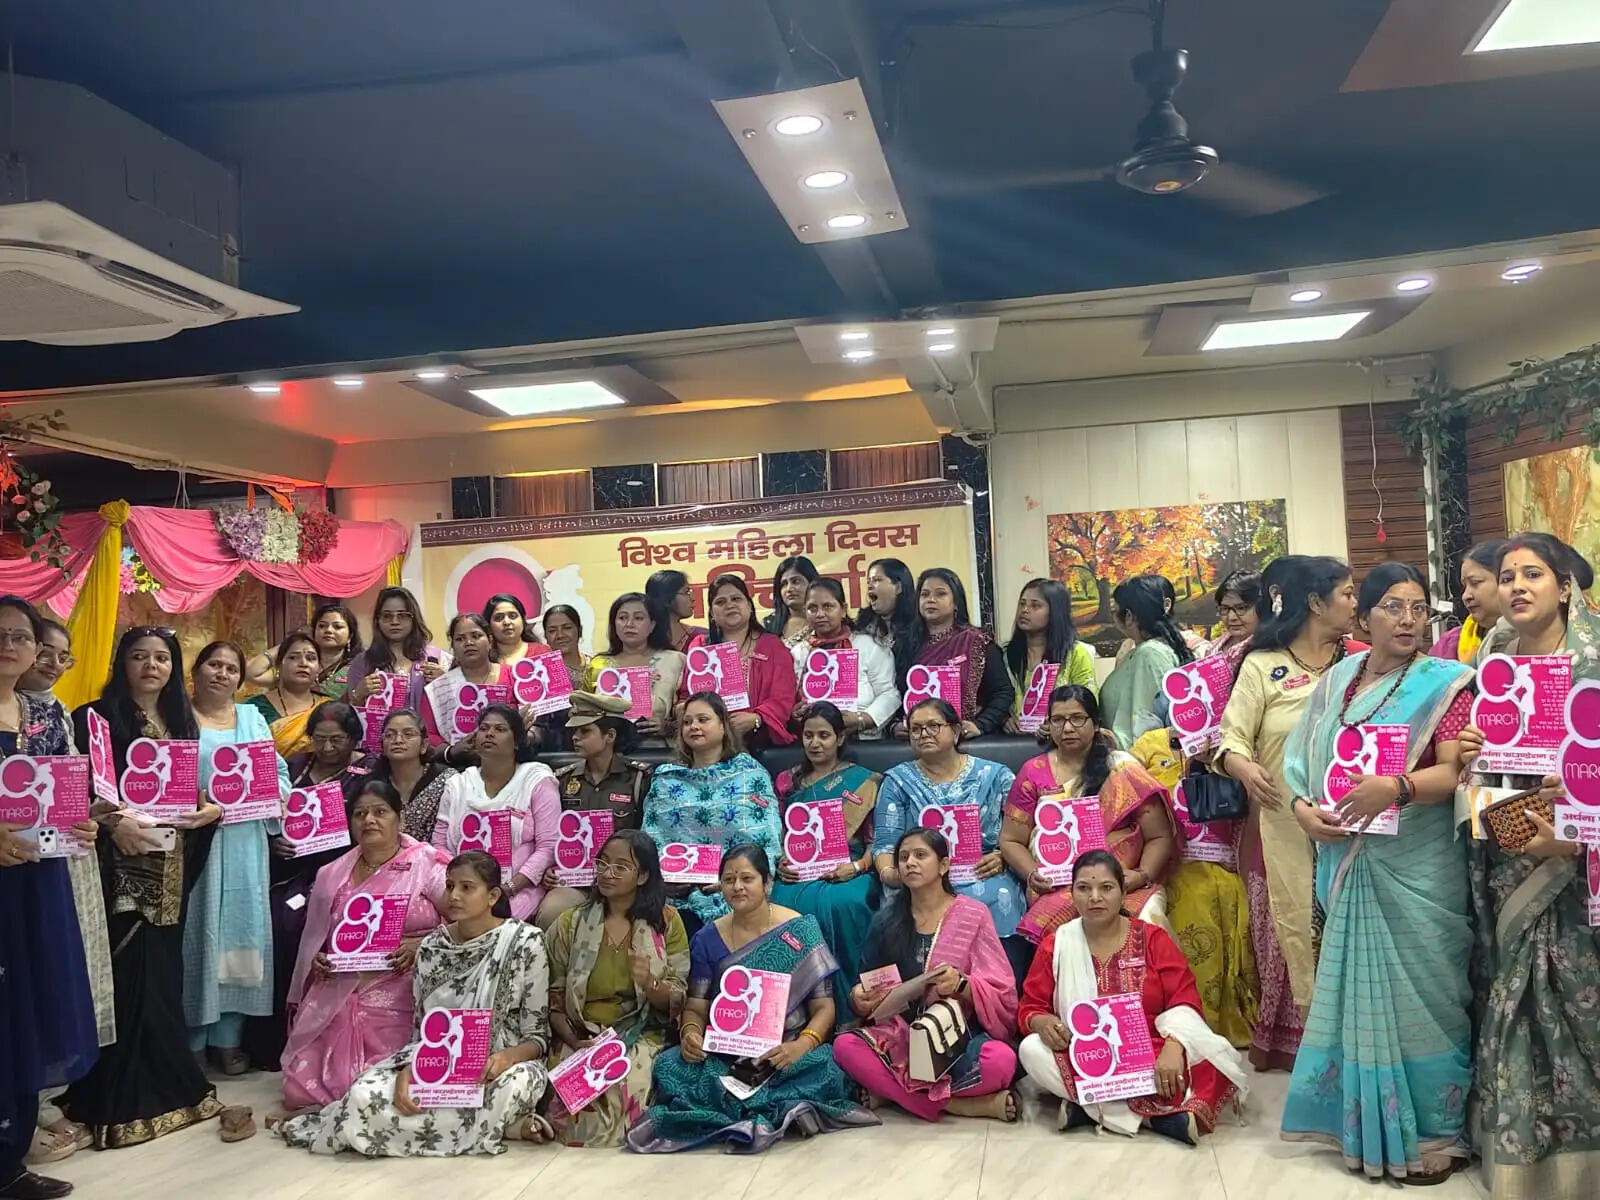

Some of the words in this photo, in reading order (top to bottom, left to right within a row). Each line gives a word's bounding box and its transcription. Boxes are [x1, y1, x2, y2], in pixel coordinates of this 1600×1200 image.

[618, 536, 698, 567] विश्व
[706, 528, 816, 560] महिला
[824, 520, 921, 552] दिवस
[1548, 666, 1569, 675] नारी
[1174, 706, 1204, 723] MARCH
[1477, 713, 1518, 726] MARCH
[126, 780, 158, 792] MARCH
[213, 783, 243, 793] MARCH
[1328, 775, 1357, 790] MARC
[1040, 841, 1070, 853] MARCH
[337, 931, 367, 942] MARCH
[715, 1008, 747, 1019] MARCH
[1076, 1047, 1110, 1064] MARCH
[416, 1056, 448, 1068] MARCH
